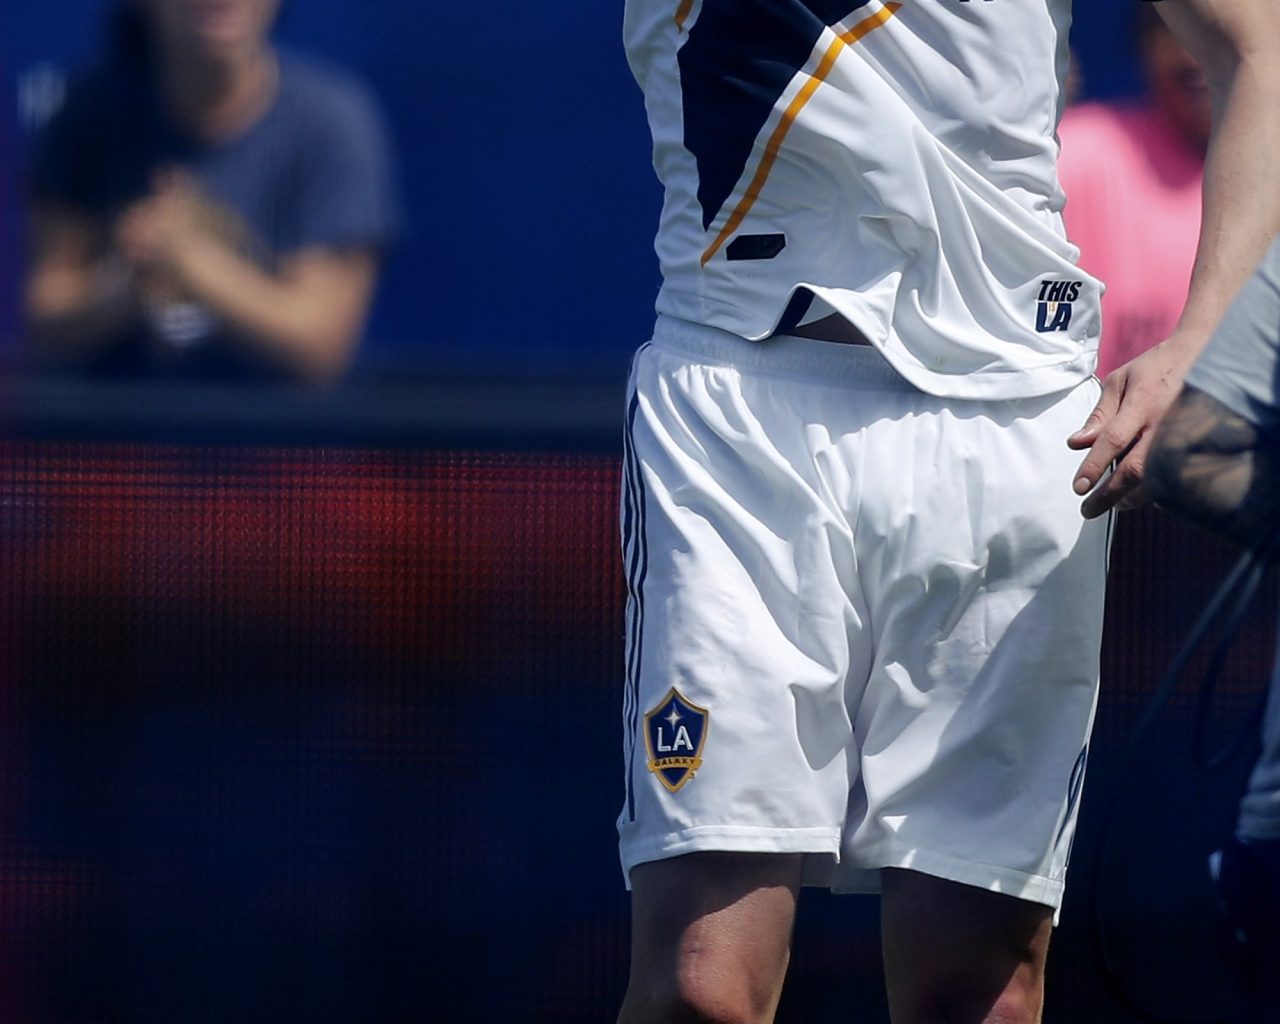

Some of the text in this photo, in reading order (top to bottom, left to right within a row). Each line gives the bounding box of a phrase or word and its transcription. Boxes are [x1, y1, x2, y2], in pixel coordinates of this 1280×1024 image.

[1038, 280, 1082, 302] THIS
[1035, 302, 1072, 333] LA
[657, 725, 694, 752] LA
[654, 758, 696, 767] GALAXY
